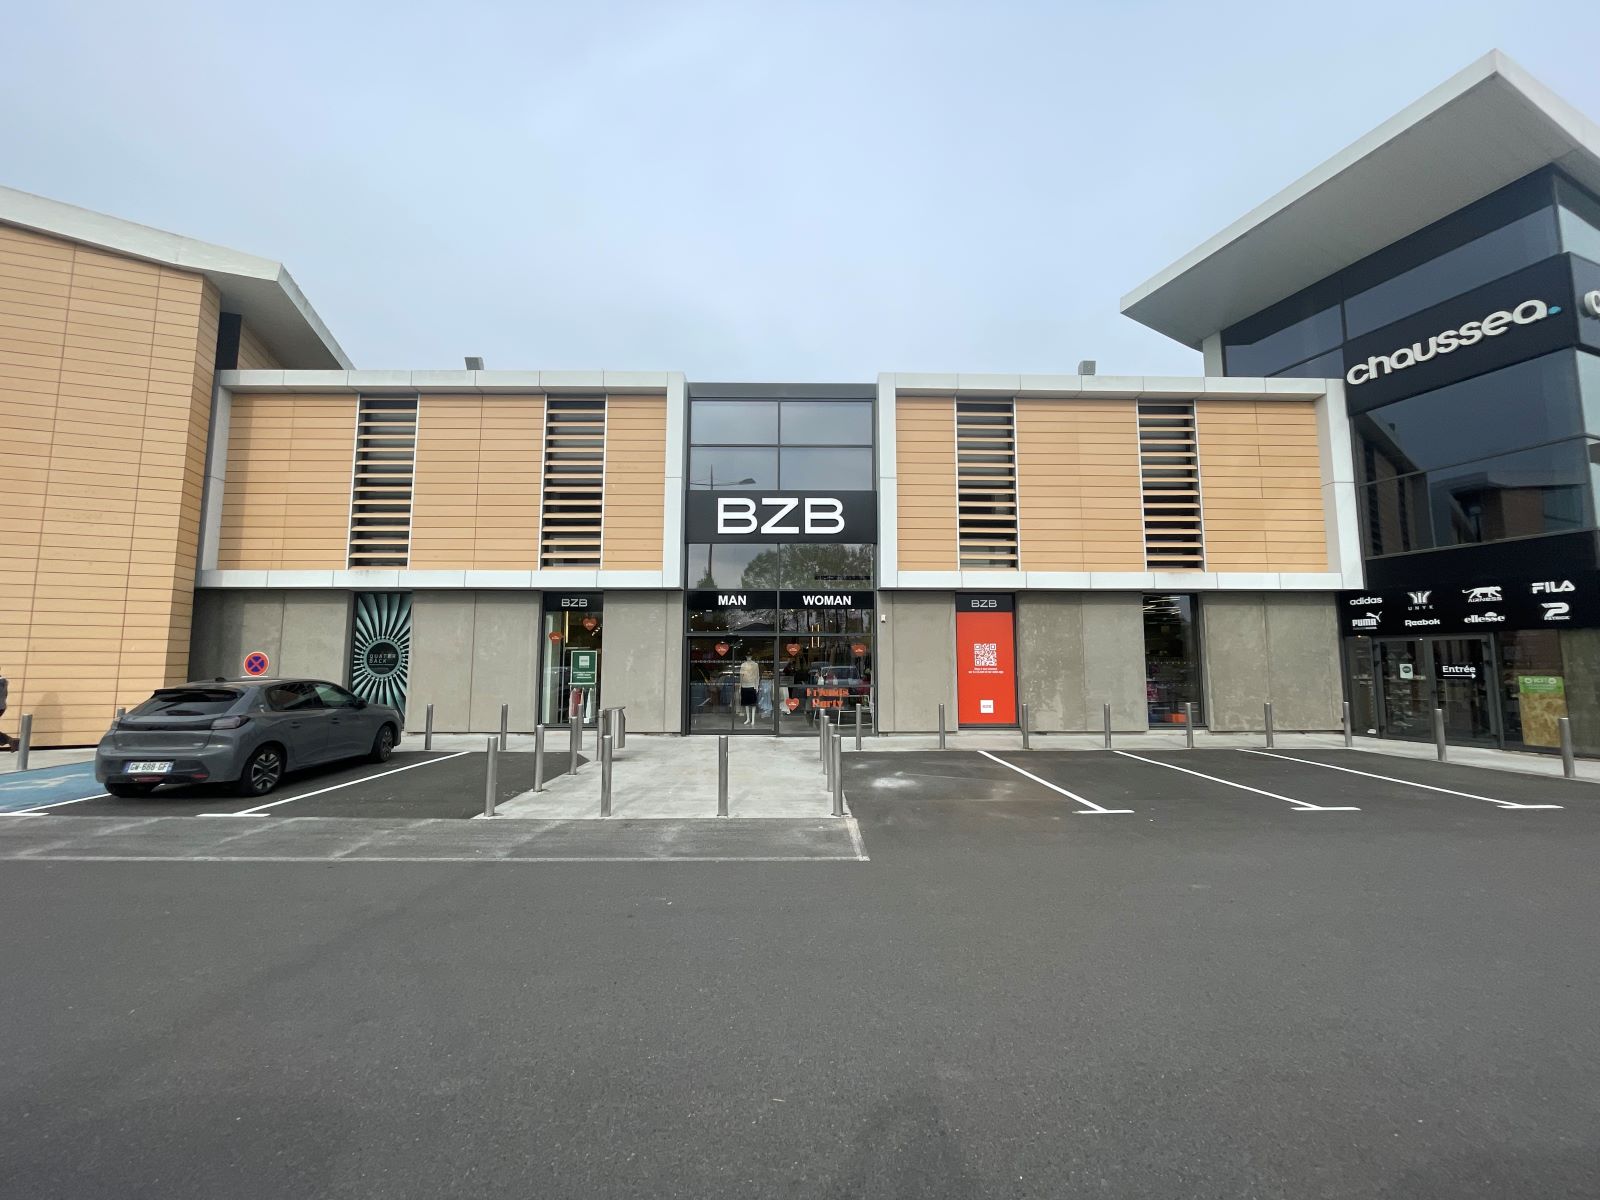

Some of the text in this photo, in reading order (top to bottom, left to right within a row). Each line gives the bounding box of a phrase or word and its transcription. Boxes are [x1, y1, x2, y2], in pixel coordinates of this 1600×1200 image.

[717, 497, 846, 534] BZB
[1531, 580, 1576, 594] FILA
[561, 599, 588, 607] BZB
[718, 595, 747, 606] MAN
[802, 595, 852, 606] WOMAN
[971, 600, 997, 608] BZB
[1349, 596, 1383, 606] adidas
[1351, 618, 1378, 627] PUMA
[1404, 618, 1441, 628] Reebok
[1463, 613, 1506, 624] ellesse
[1442, 664, 1476, 673] Entrée
